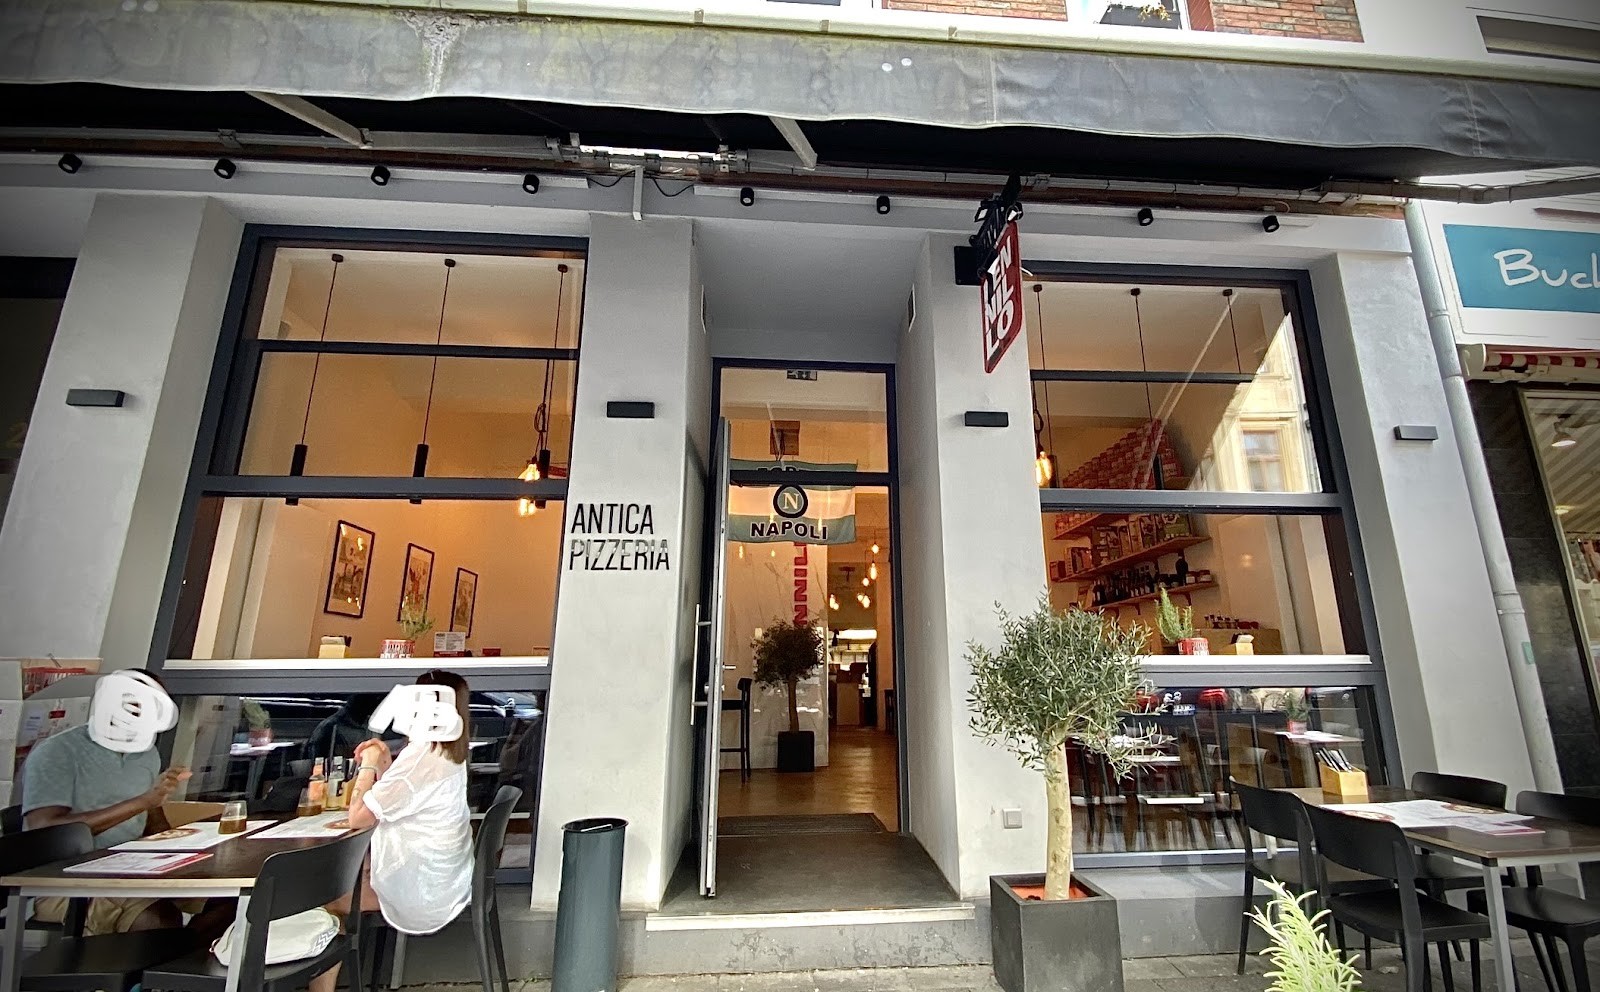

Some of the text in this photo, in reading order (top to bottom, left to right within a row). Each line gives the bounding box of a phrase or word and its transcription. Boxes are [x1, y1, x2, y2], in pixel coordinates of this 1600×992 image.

[985, 299, 1014, 361] LO
[782, 492, 800, 510] N
[570, 503, 654, 535] ANTICA
[750, 520, 828, 540] NAPOLI
[569, 538, 670, 571] PIZZERIA
[793, 541, 808, 626] NNIL
